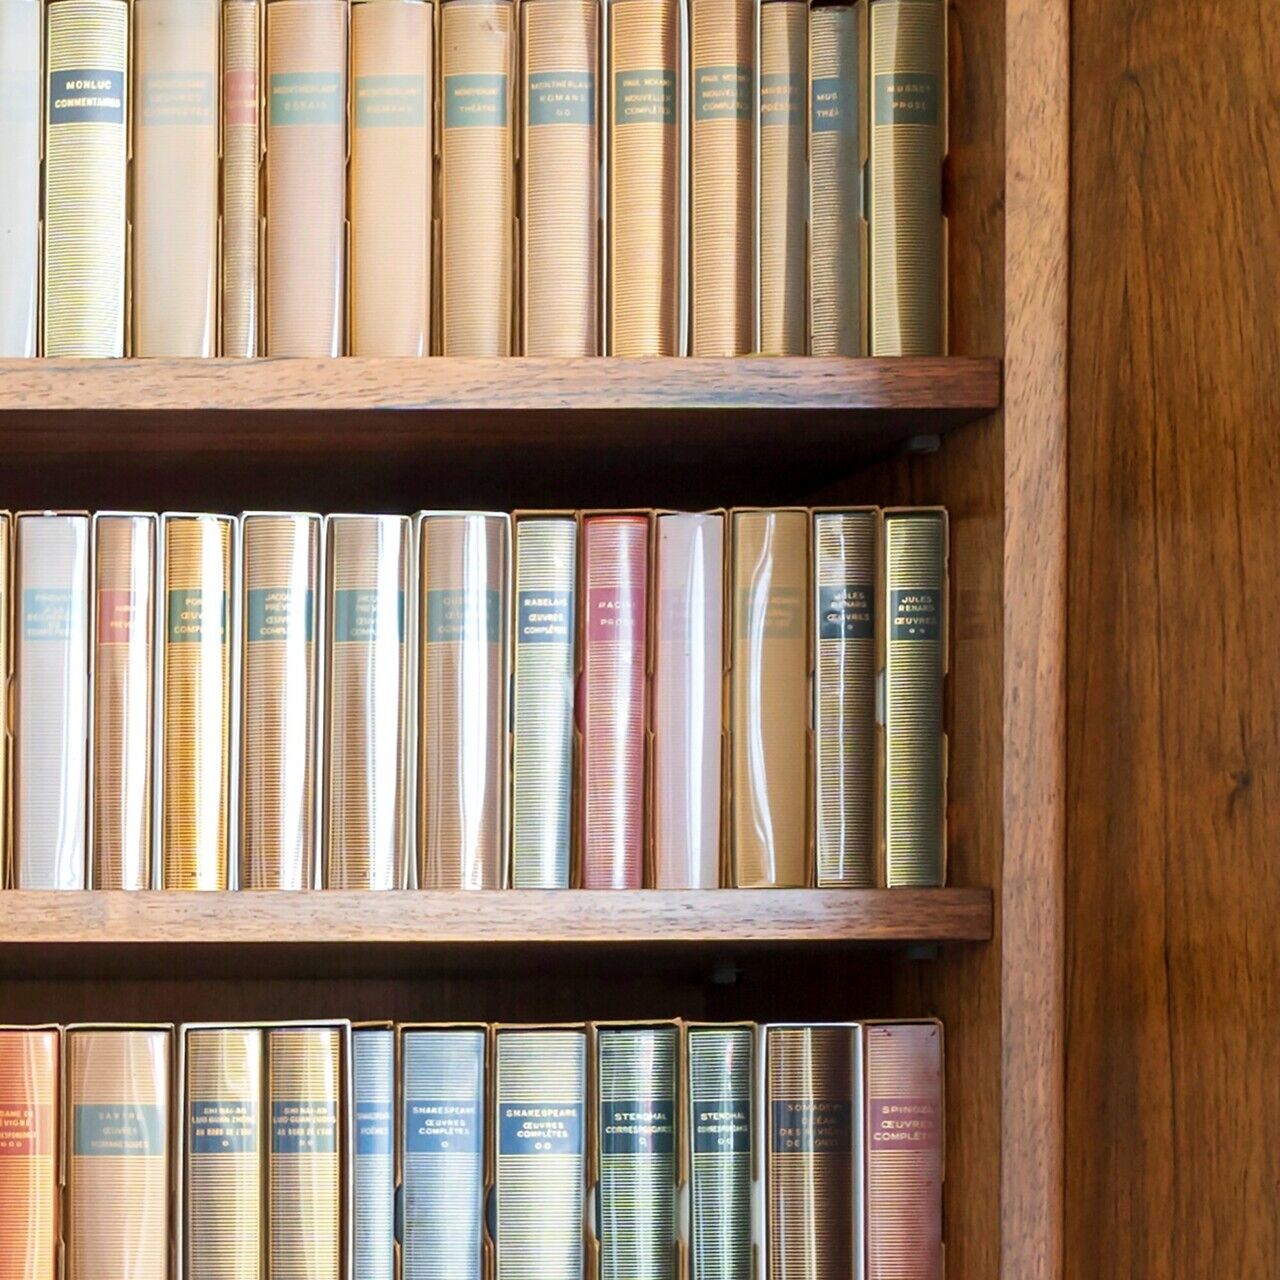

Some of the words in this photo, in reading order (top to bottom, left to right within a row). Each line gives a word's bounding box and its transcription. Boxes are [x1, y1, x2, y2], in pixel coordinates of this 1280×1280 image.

[66, 79, 113, 90] MONLUC
[523, 597, 568, 607] RABELAIS
[902, 595, 932, 604] JULES
[506, 1108, 577, 1118] SHAKESPEARE
[523, 1121, 564, 1130] ŒUVRES
